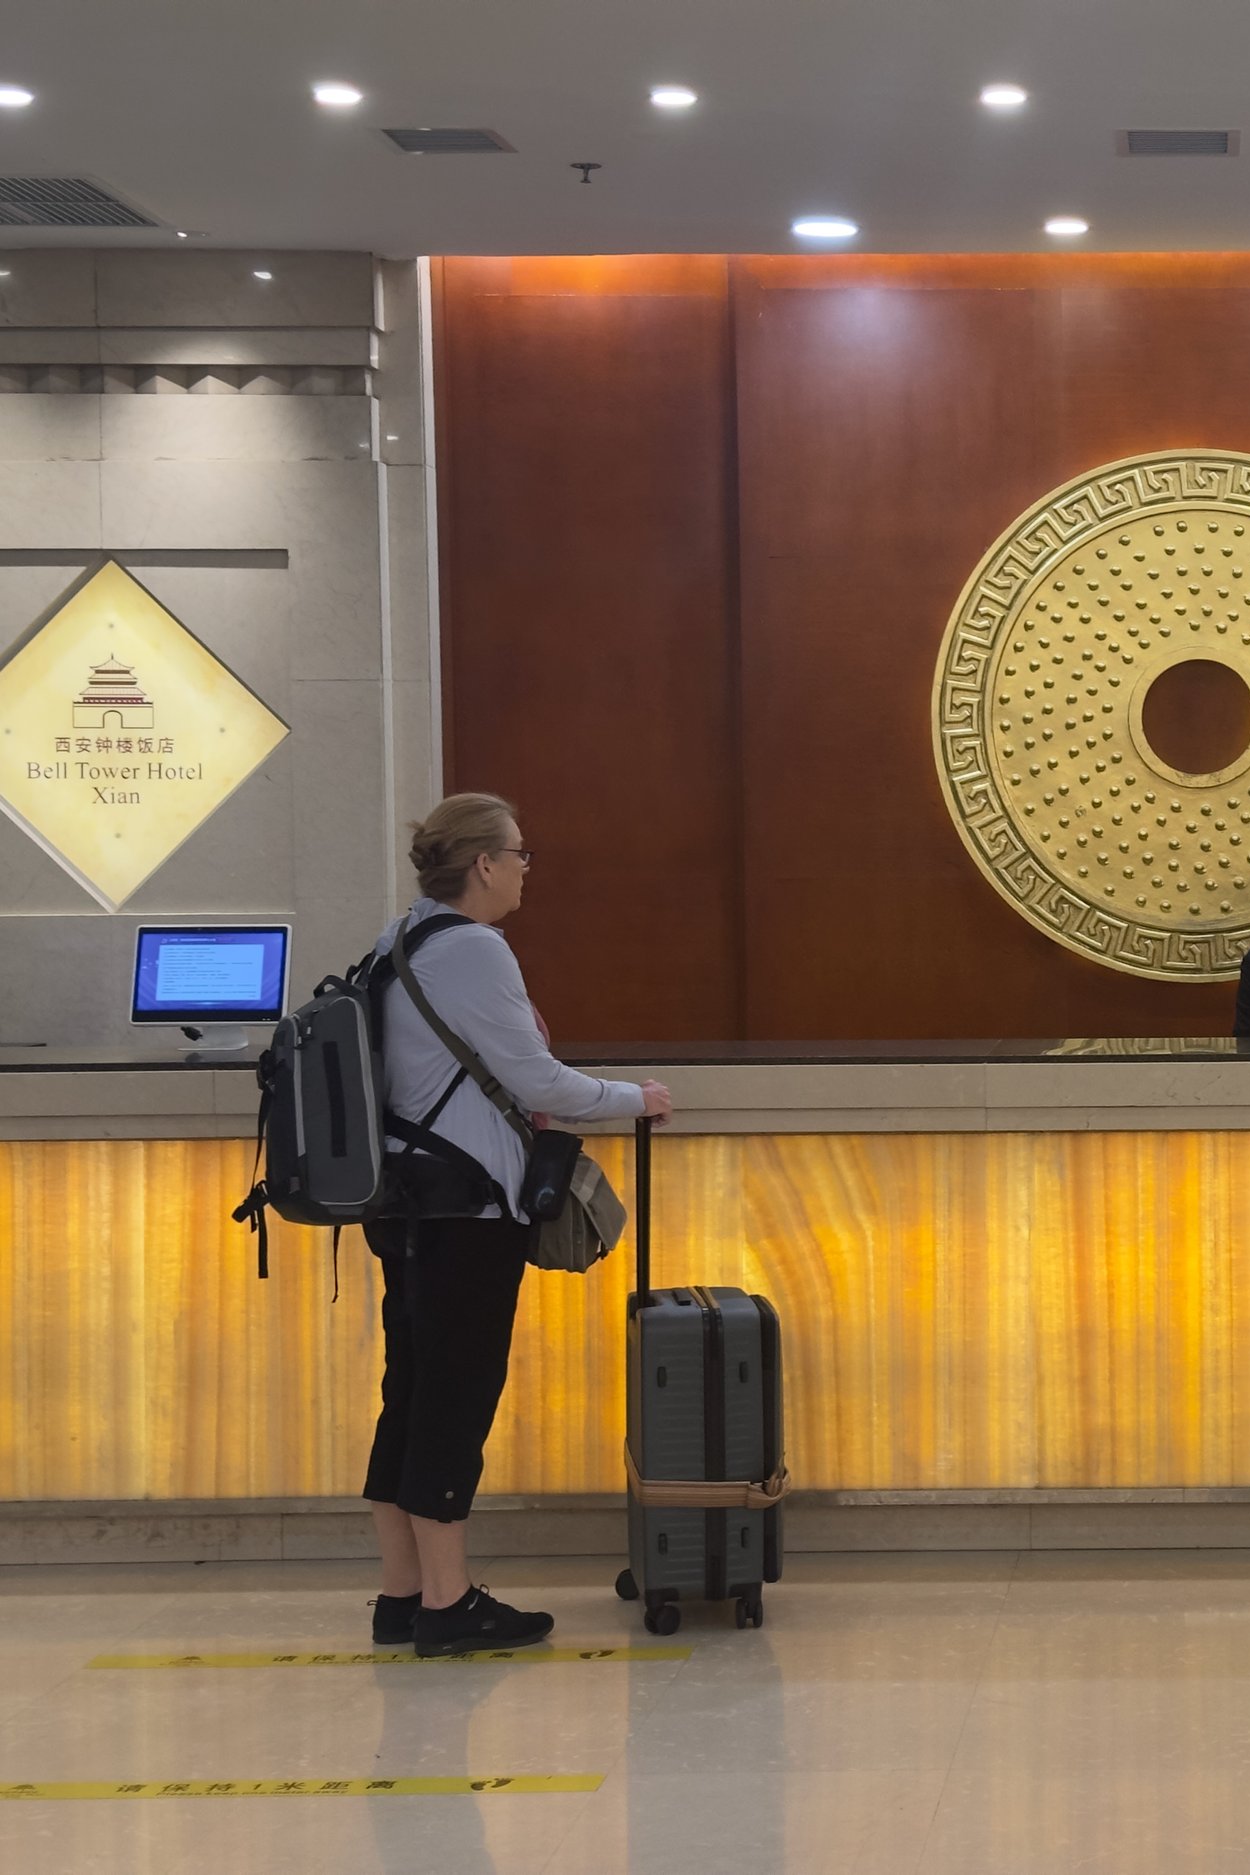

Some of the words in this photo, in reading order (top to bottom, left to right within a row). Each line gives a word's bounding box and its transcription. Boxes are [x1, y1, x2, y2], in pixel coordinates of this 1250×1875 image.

[55, 736, 175, 754] 西安钟楼饭店
[27, 761, 68, 780] Bell
[75, 761, 140, 780] Tower
[148, 762, 203, 780] Hotel
[92, 786, 141, 804] Xian
